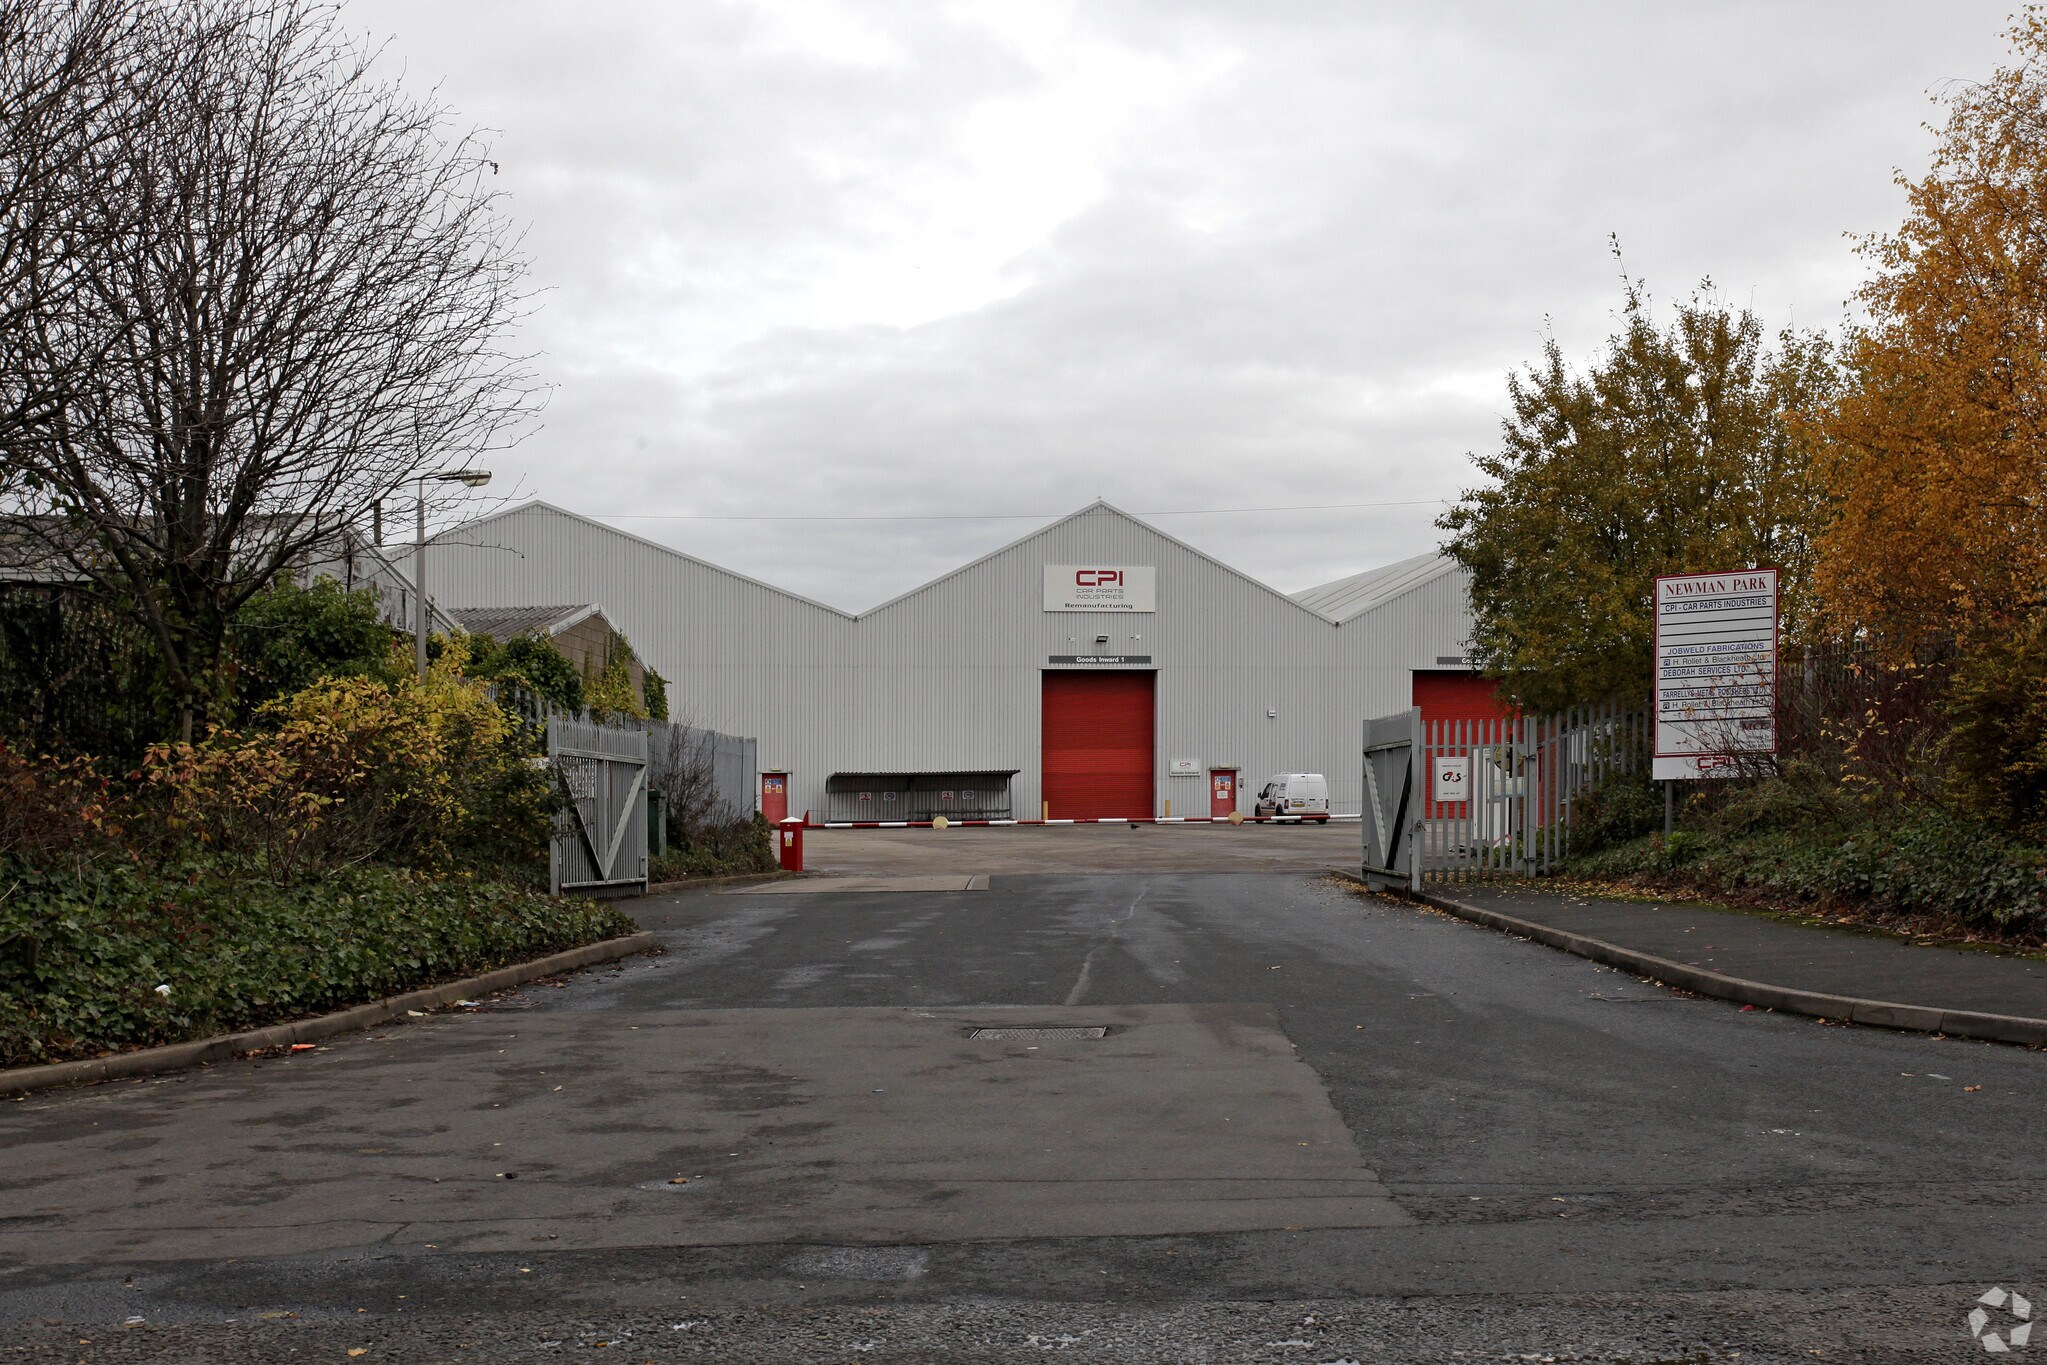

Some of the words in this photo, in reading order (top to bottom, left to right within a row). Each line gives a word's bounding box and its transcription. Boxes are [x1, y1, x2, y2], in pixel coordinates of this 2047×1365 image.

[1076, 570, 1124, 586] CPI
[1666, 580, 1726, 596] NEWMAN
[1733, 577, 1766, 592] PARK
[1665, 604, 1677, 612] CPI
[1683, 603, 1698, 611] CAR
[1700, 601, 1722, 609] PARTS
[1724, 598, 1766, 608] INDUSTRIES
[1668, 646, 1704, 655] JOBWELD
[1707, 642, 1764, 652] FABRICATIONS
[1663, 668, 1696, 677] DEBORAH
[1698, 666, 1730, 675] SERVICES
